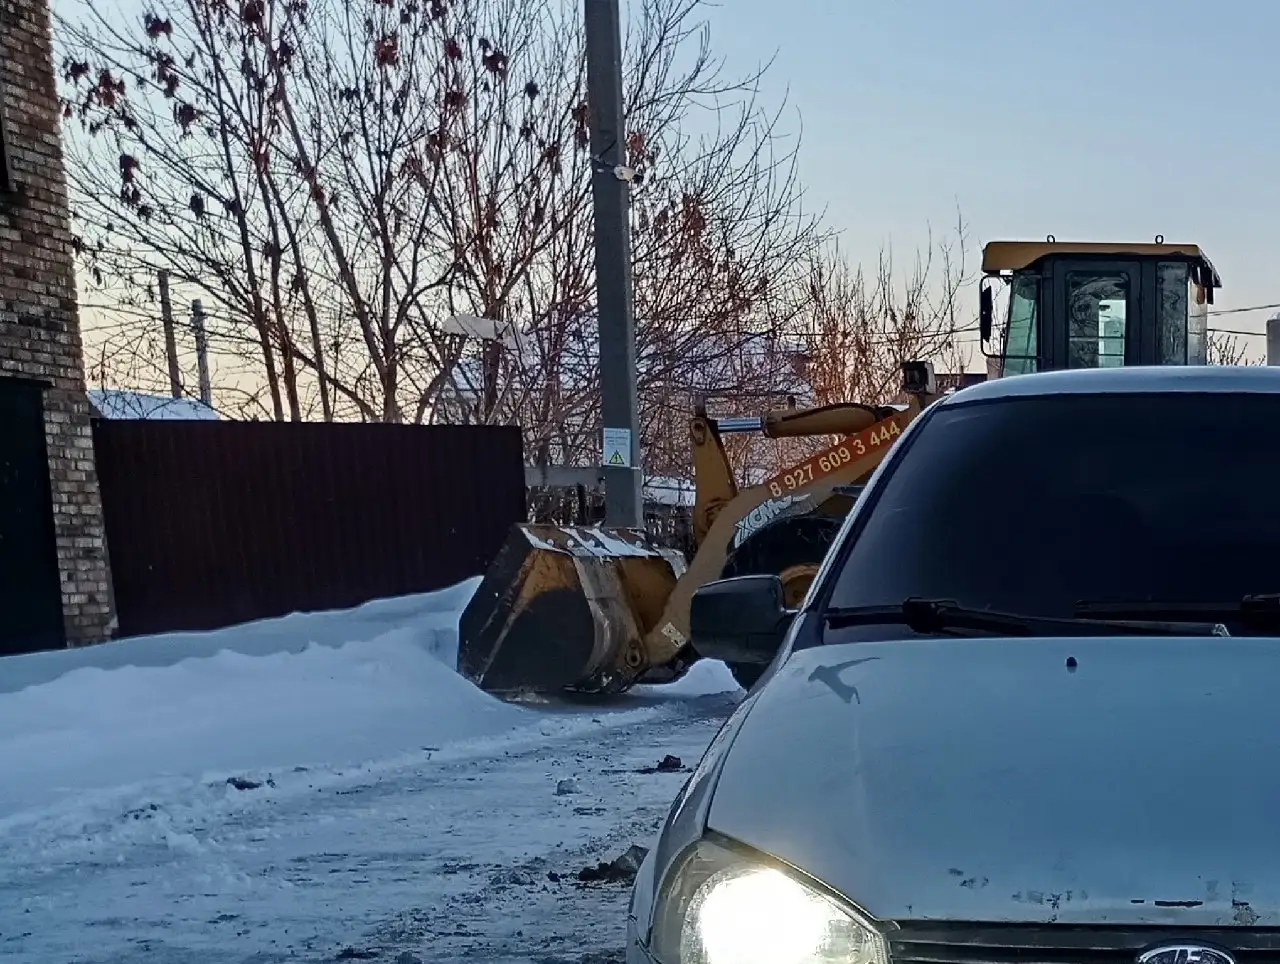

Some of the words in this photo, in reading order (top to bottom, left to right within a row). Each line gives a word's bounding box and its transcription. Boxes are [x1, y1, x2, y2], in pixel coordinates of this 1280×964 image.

[770, 482, 782, 497] 8
[784, 464, 815, 490] 927
[819, 447, 851, 472] 609
[853, 439, 866, 455] 3
[869, 421, 900, 446] 444
